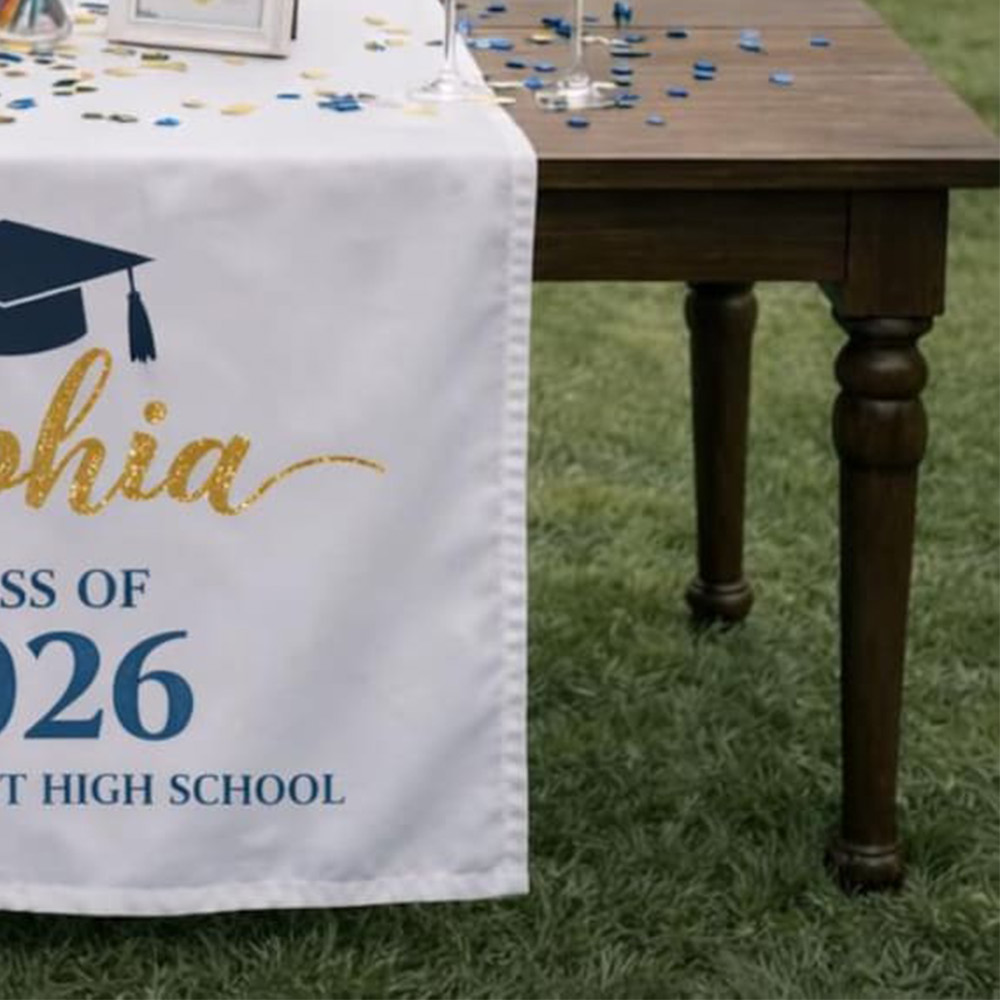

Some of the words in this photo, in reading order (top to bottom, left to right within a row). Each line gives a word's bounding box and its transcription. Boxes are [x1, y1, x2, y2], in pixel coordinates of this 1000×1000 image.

[77, 569, 150, 610] OF
[43, 773, 153, 807] HIGH
[169, 773, 346, 807] SCHOOL
